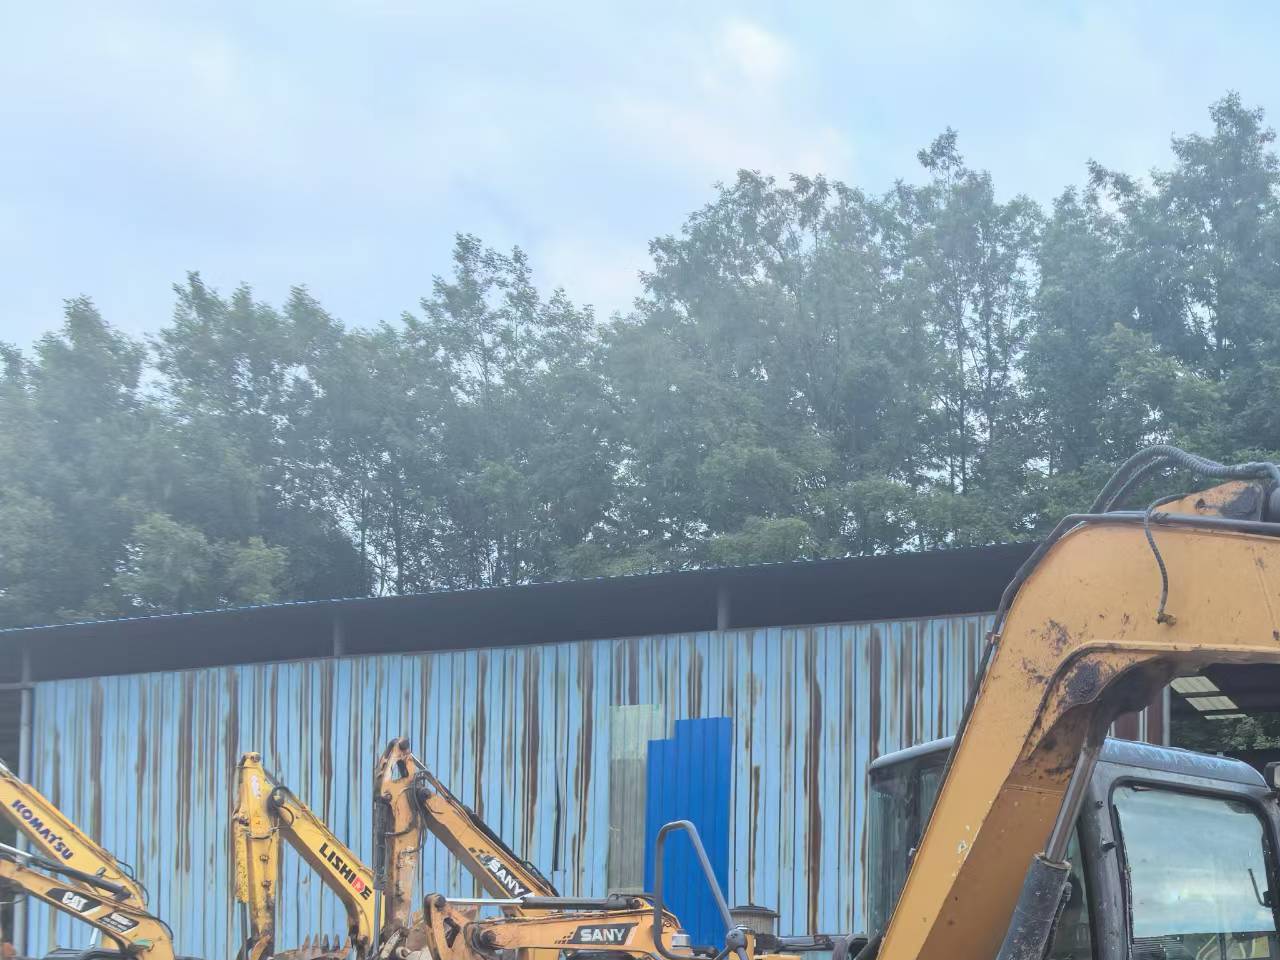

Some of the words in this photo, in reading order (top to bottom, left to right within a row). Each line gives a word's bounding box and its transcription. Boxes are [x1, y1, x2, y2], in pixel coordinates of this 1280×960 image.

[12, 800, 74, 860] KOMATSU
[319, 843, 372, 900] LISHIDE
[488, 858, 524, 895] SANY
[62, 892, 88, 911] CAT
[580, 928, 625, 941] SANY
